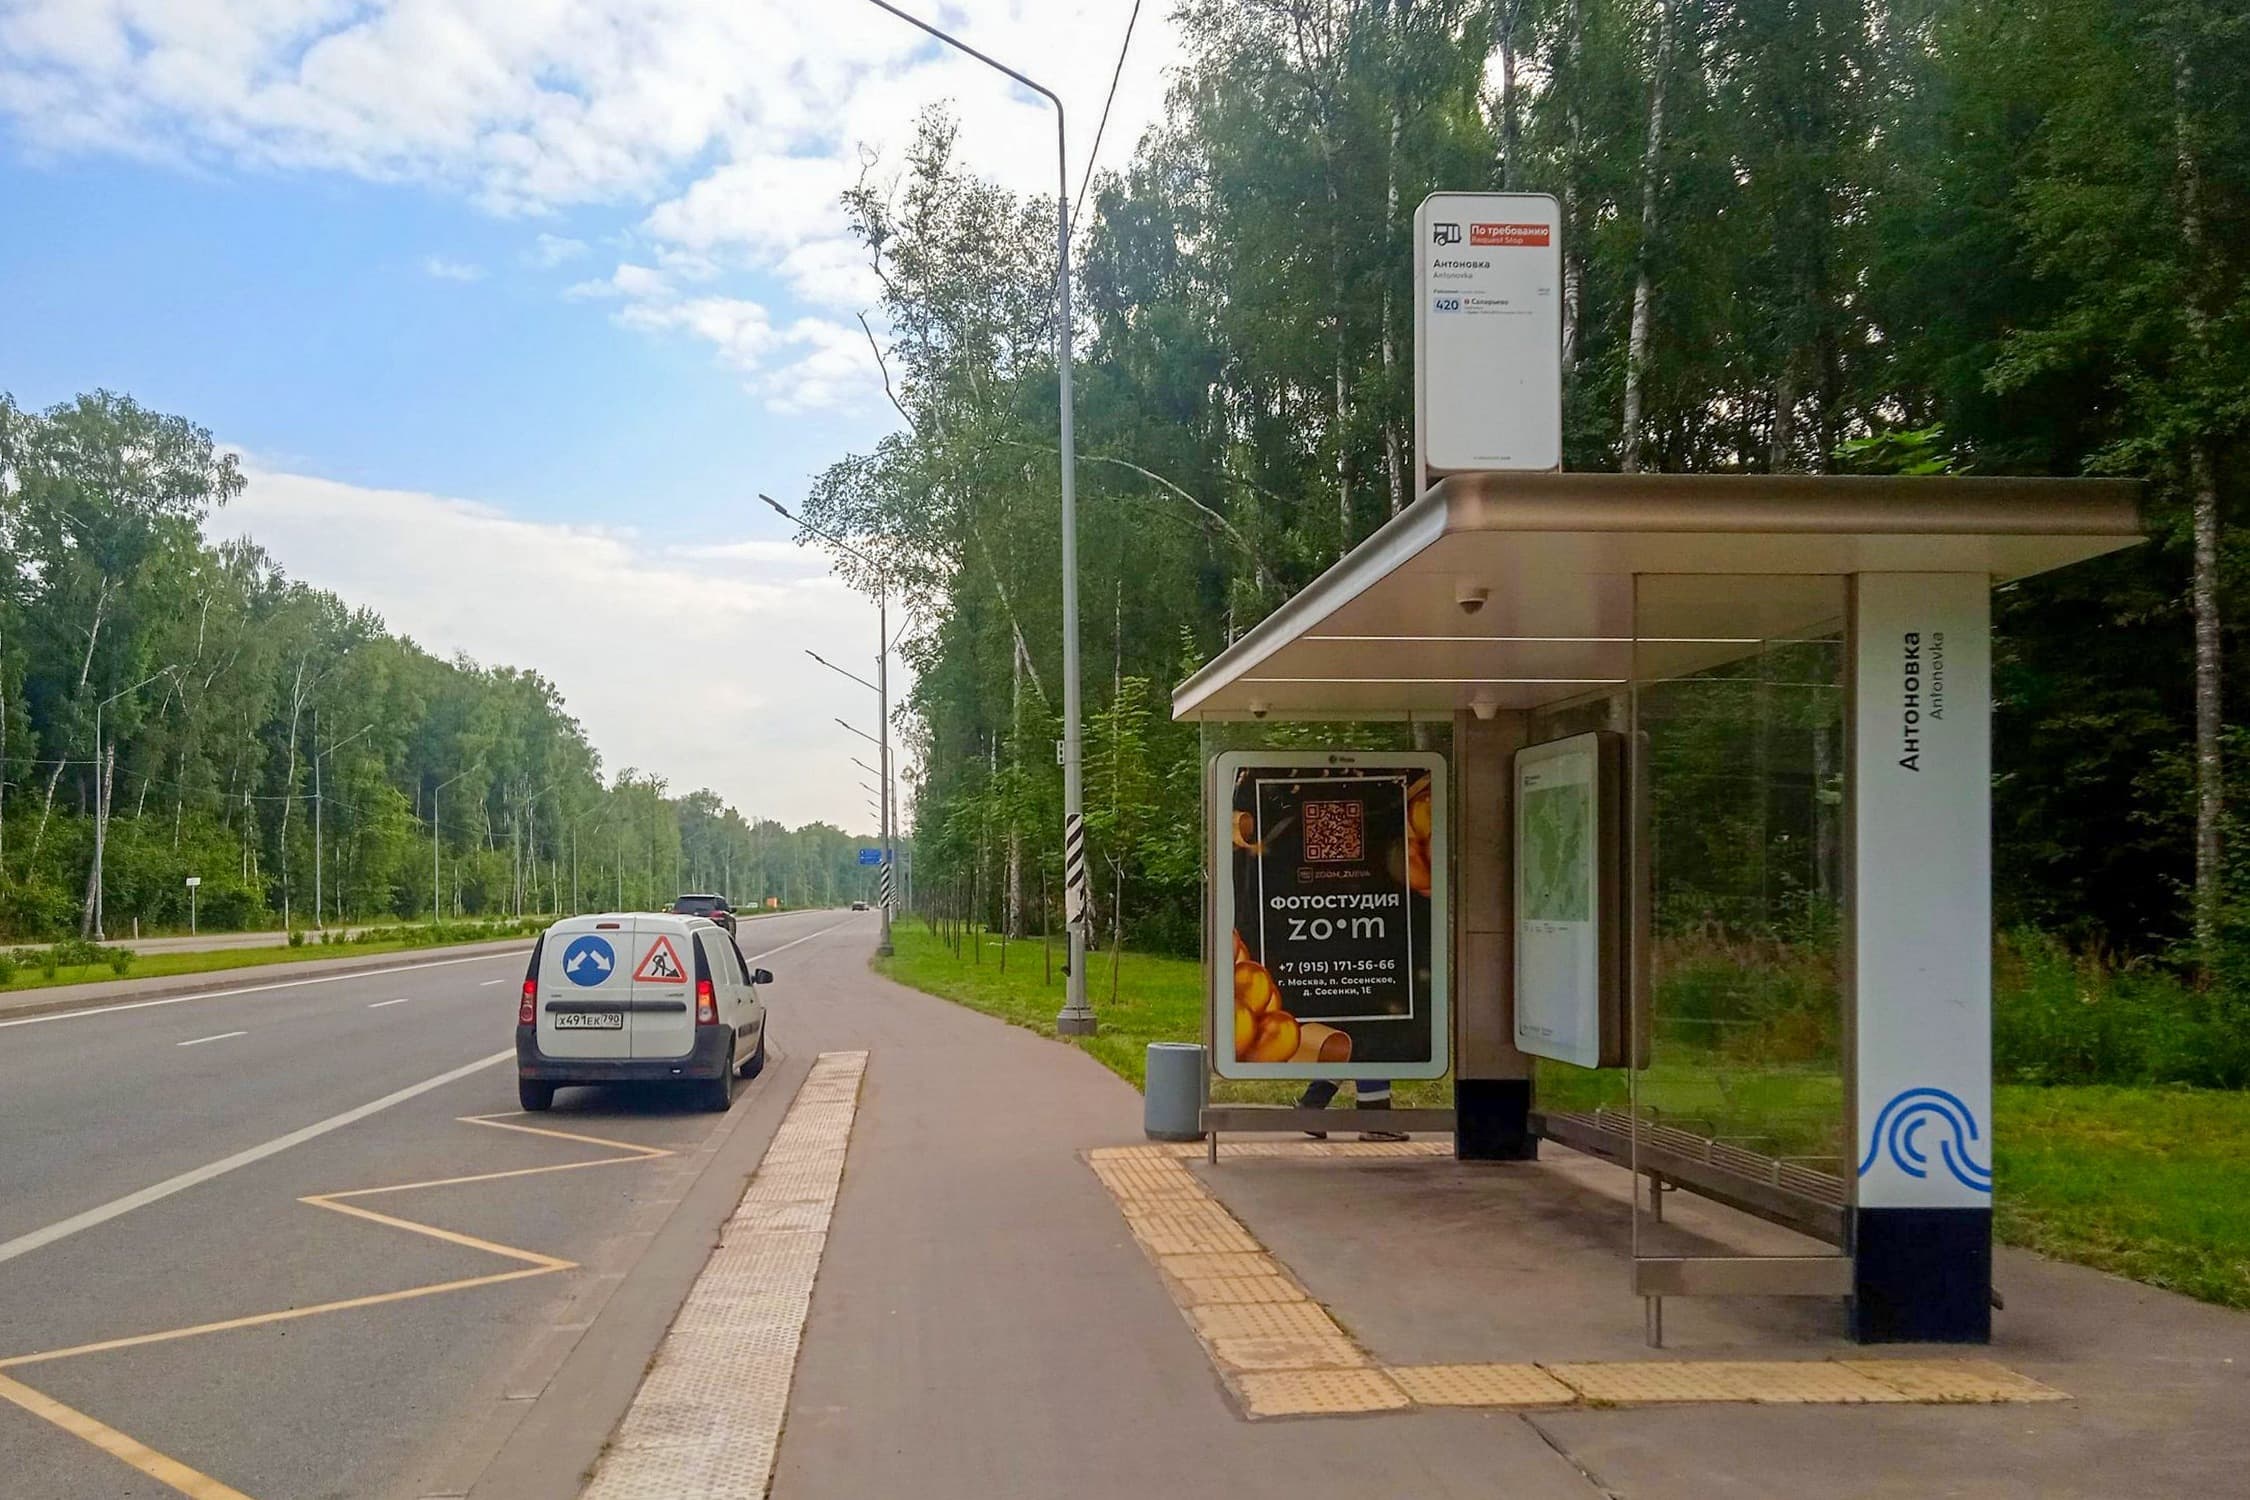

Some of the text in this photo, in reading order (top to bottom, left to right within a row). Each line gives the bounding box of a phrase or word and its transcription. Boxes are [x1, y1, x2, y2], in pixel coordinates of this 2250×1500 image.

[1471, 225, 1549, 237] По требованию
[1433, 259, 1490, 269] Антоновка
[1436, 300, 1459, 311] 420
[1929, 632, 1944, 720] Antonovka
[1899, 632, 1921, 772] Антоновка
[1270, 893, 1400, 910] ФОТОСТУДИЯ
[1279, 959, 1395, 974] +7 (915) 171-56-66
[1287, 978, 1328, 986] Москва,
[1341, 976, 1396, 985] Сосенское,
[1303, 988, 1312, 996] д.
[1315, 987, 1360, 996] Сосенки,
